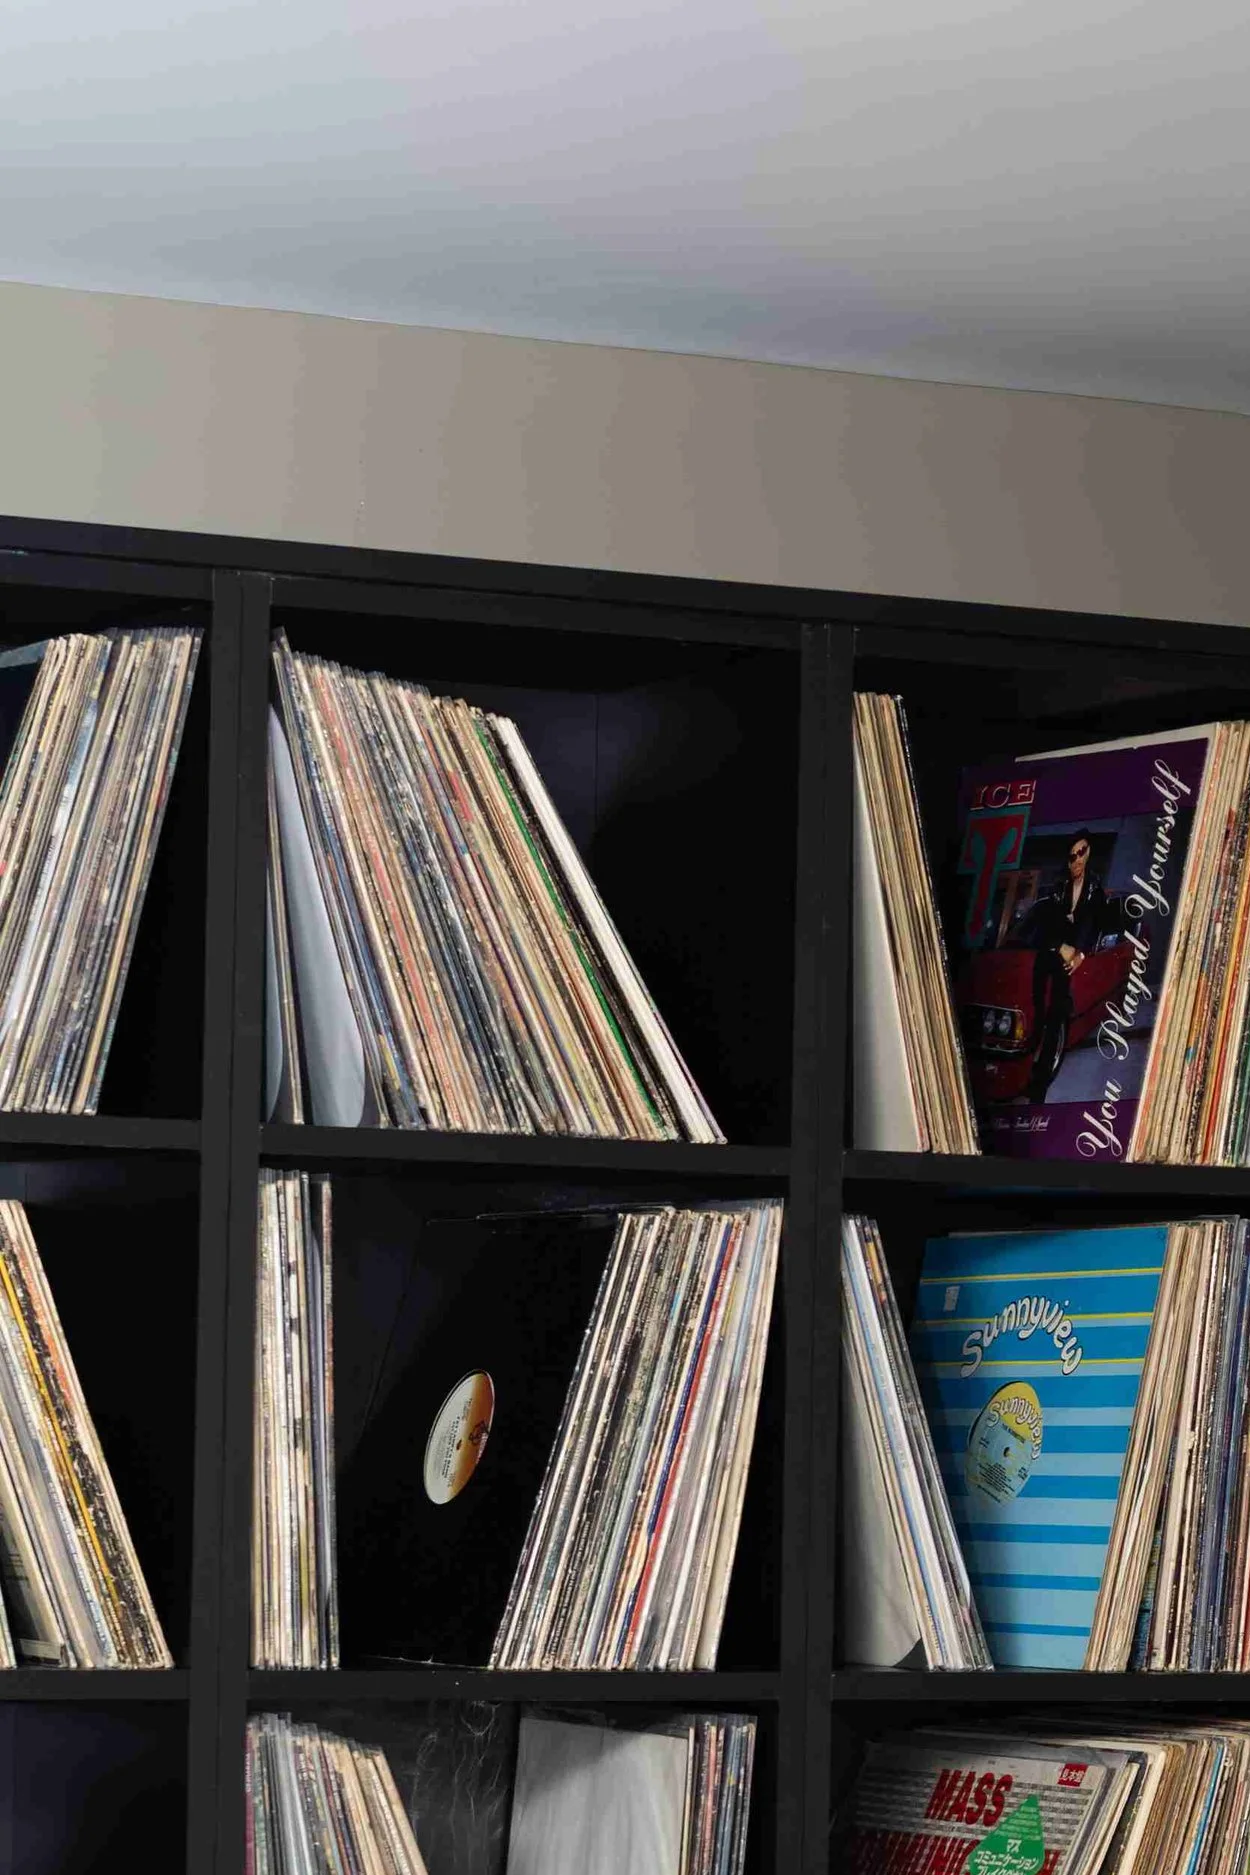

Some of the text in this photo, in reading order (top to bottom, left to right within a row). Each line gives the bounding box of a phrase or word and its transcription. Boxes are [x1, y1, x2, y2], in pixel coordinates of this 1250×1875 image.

[970, 780, 1036, 810] ICE
[1075, 759, 1191, 1157] You Played Yourself
[960, 1296, 1083, 1380] Sunnyview
[987, 1397, 1041, 1461] Sunnyview
[924, 1768, 1014, 1828] MASS
[1005, 1838, 1022, 1853] マス
